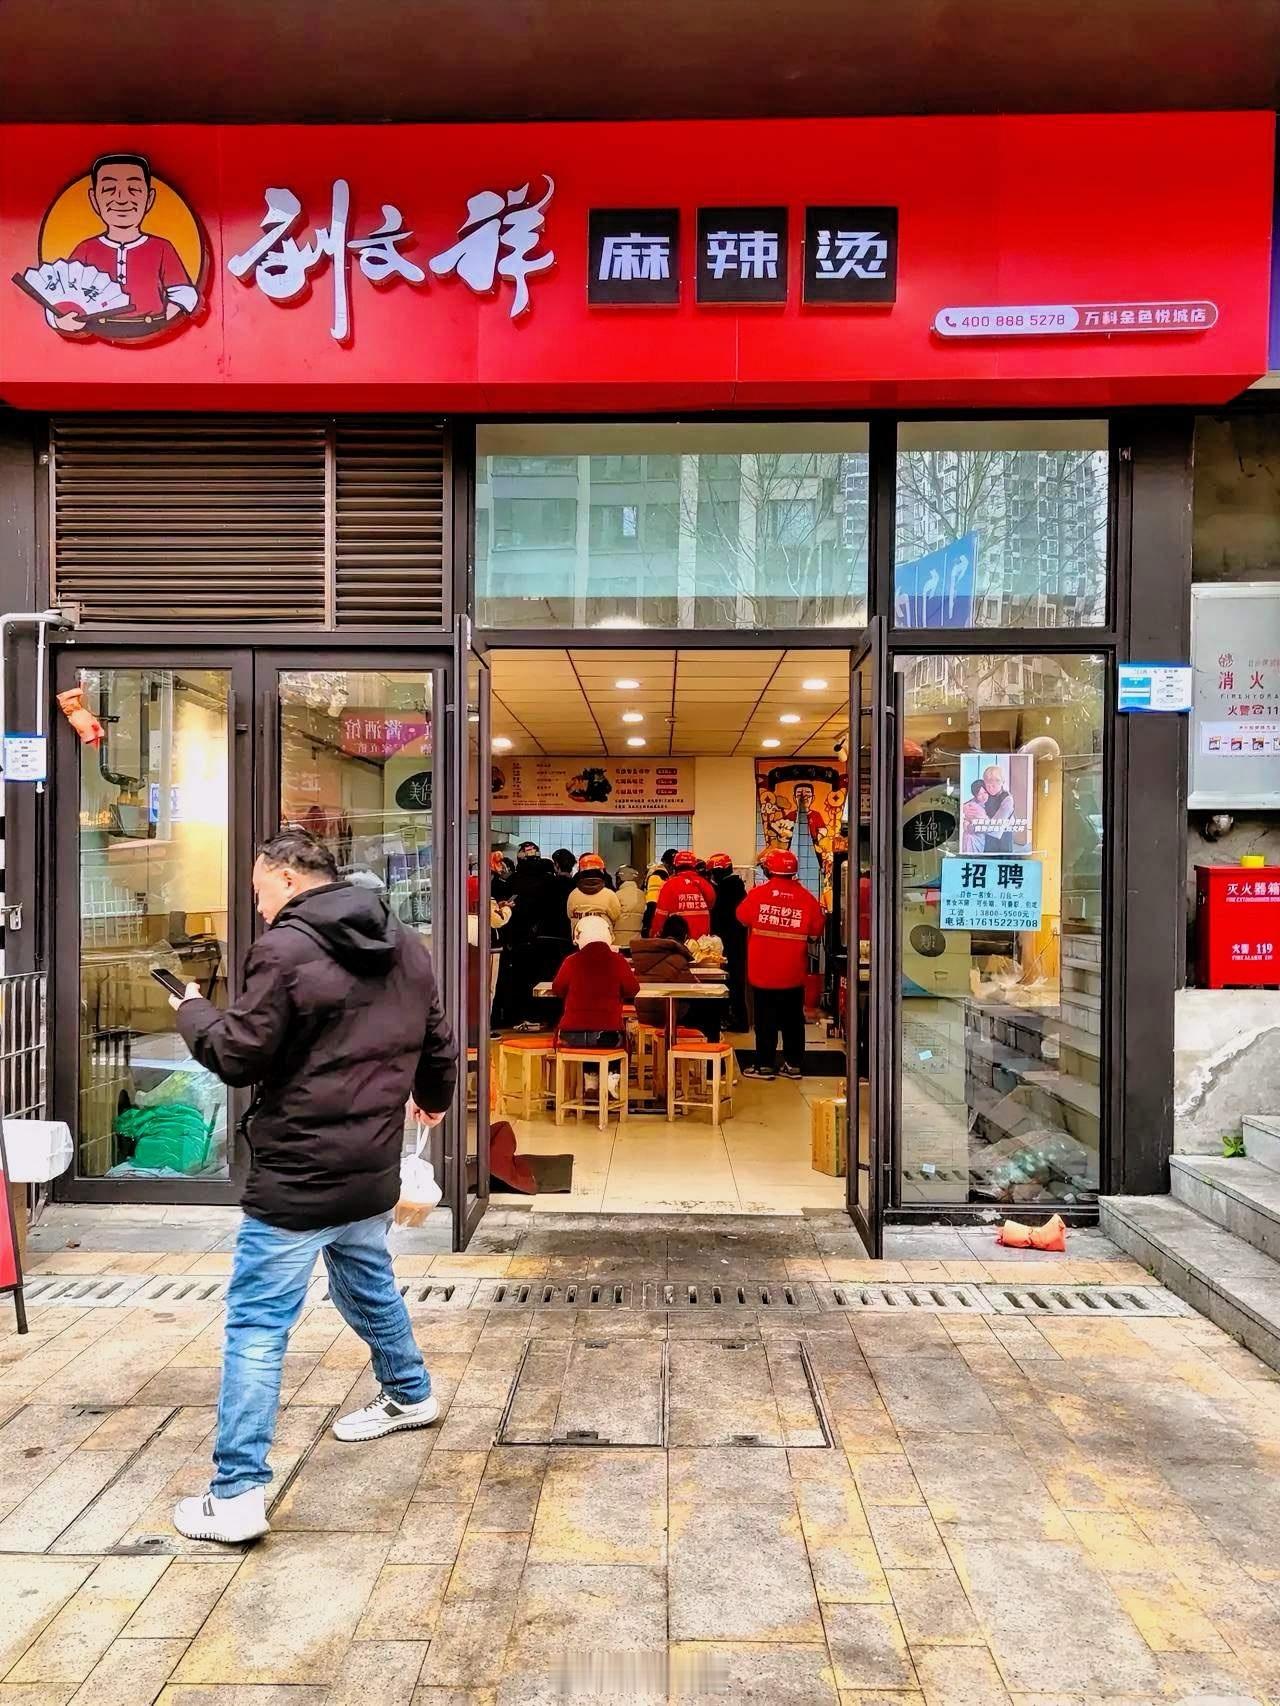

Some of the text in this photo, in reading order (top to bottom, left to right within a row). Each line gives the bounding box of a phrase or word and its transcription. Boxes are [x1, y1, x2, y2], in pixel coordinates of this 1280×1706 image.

[599, 230, 888, 281] 麻辣烫
[961, 308, 1207, 328] 400 888 5278 万科金色悦城店
[961, 862, 1024, 889] 招聘
[1227, 882, 1280, 897] 灭火器箱
[1256, 943, 1273, 955] 119
